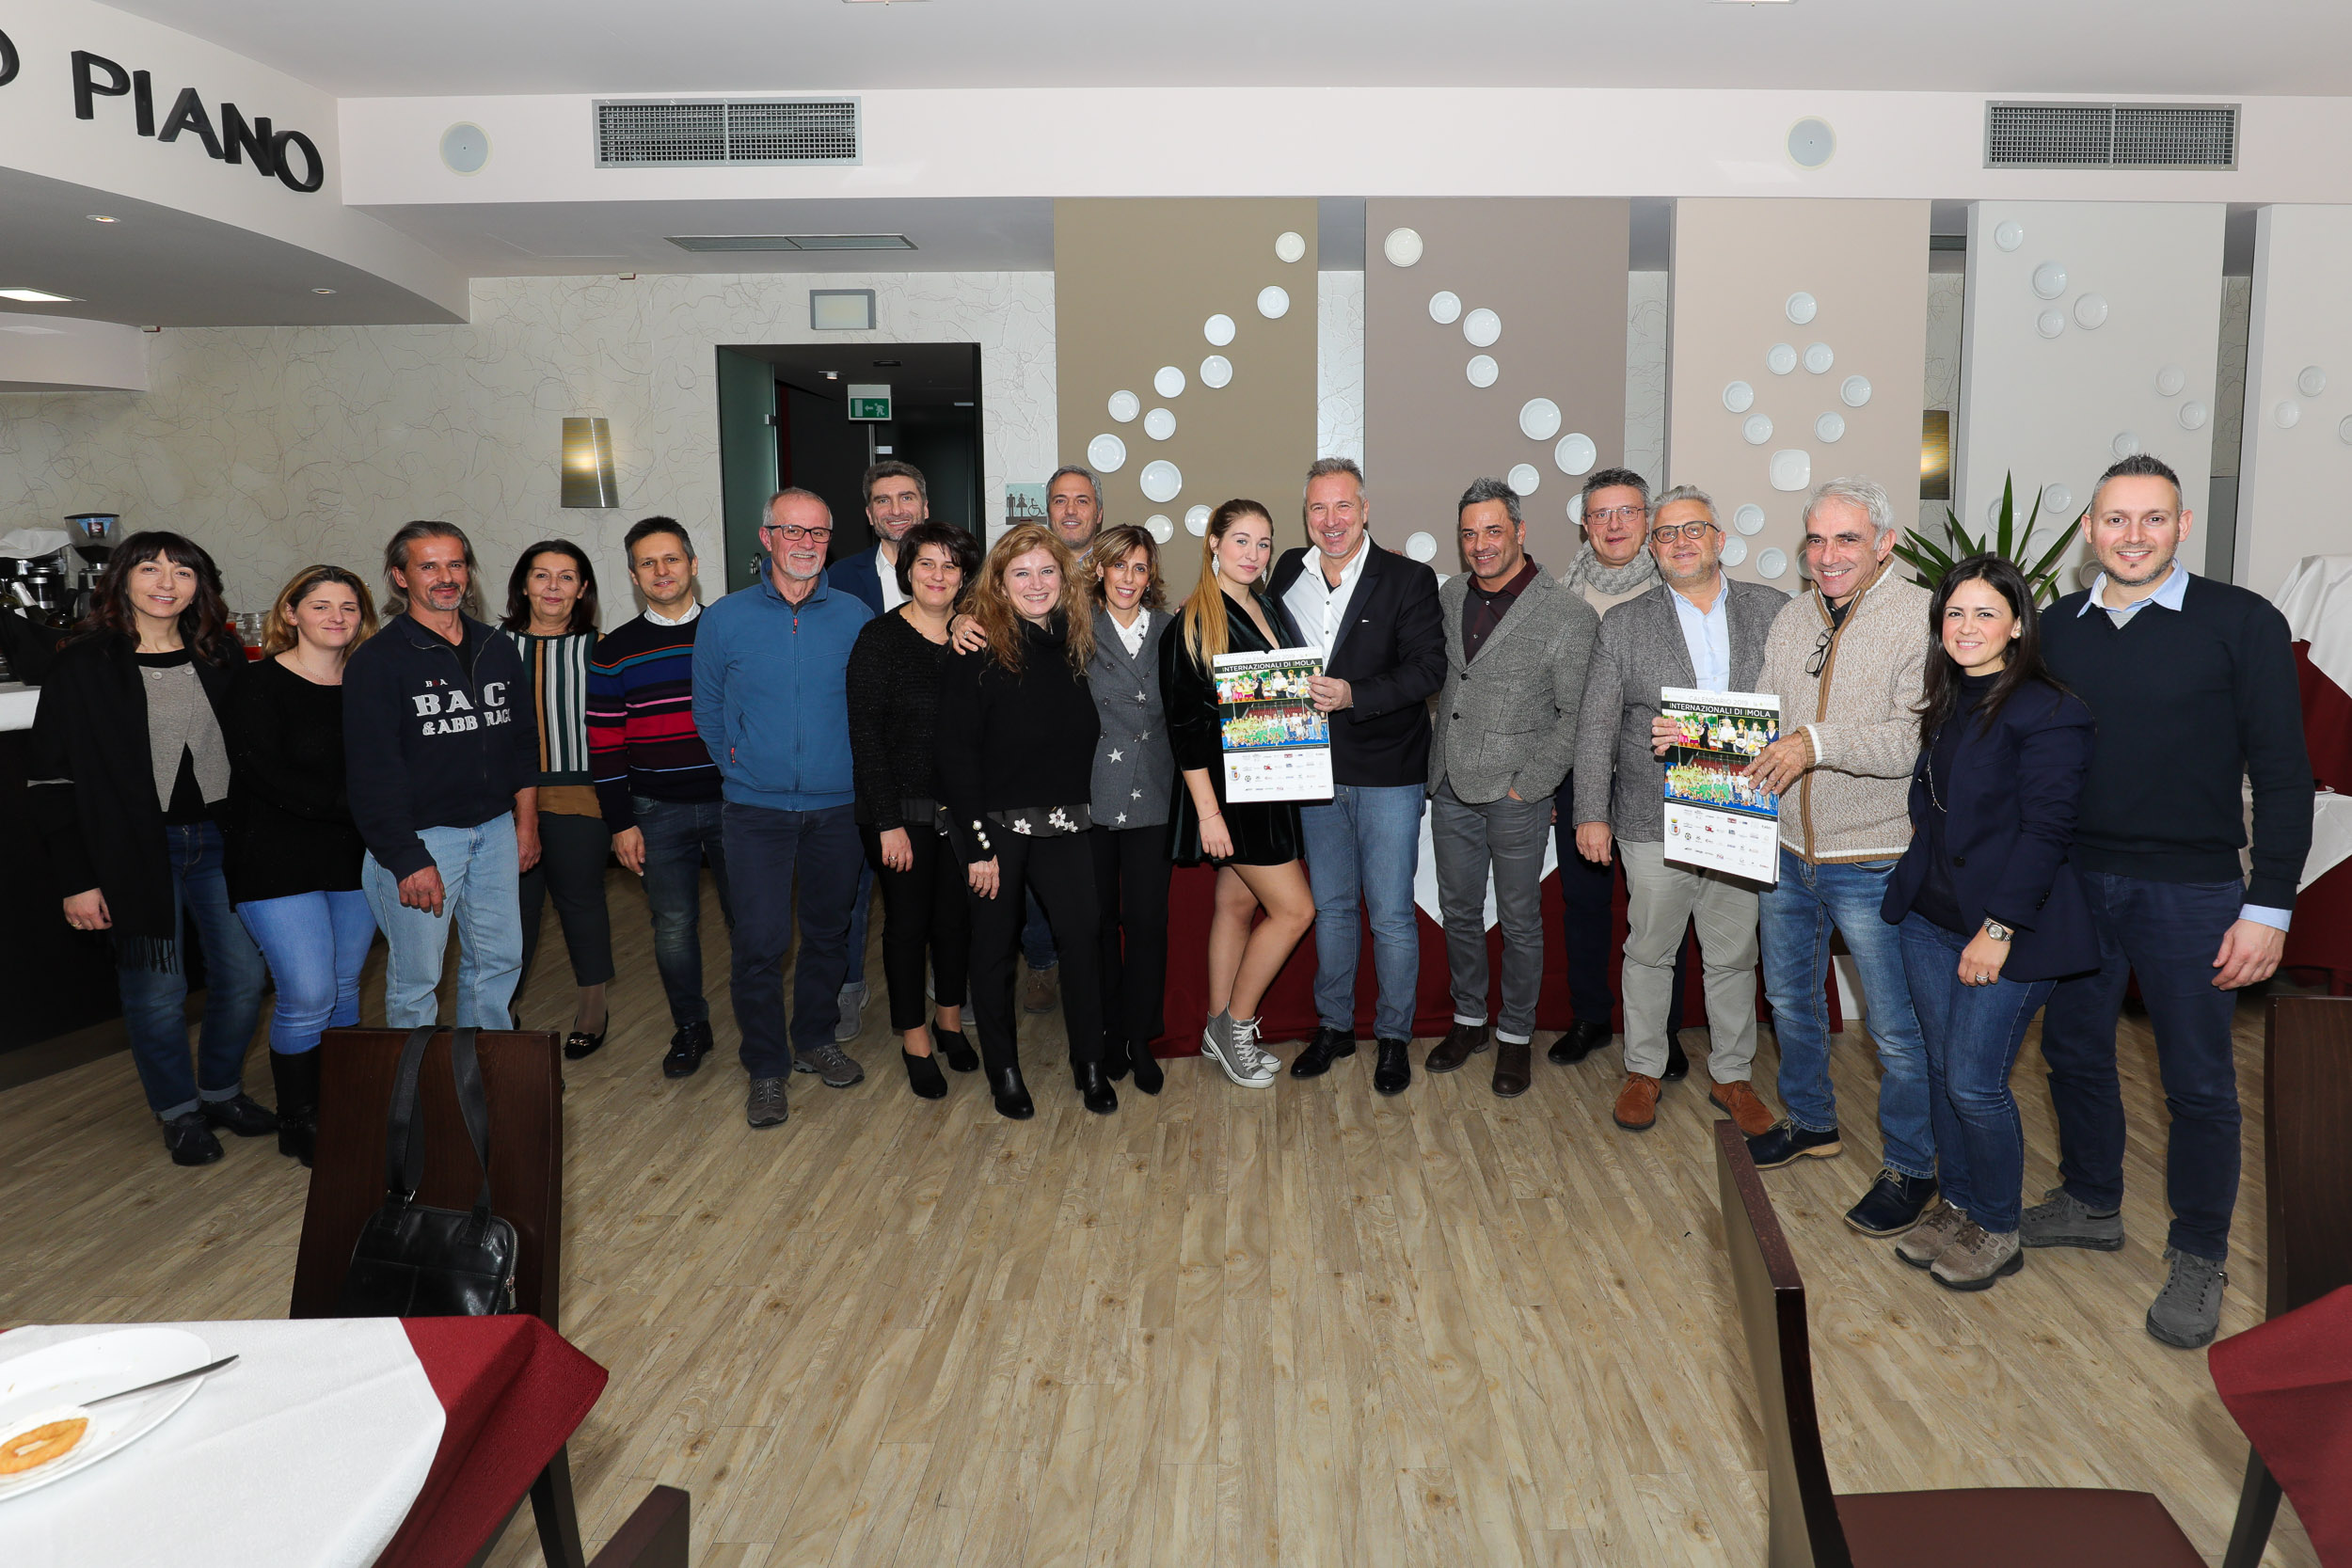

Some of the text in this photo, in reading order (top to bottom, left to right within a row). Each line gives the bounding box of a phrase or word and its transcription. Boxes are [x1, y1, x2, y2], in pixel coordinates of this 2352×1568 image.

[72, 50, 325, 193] PIANO
[1241, 655, 1280, 663] CALENDARIO
[1222, 662, 1282, 673] INTERNAZIONALI
[1689, 696, 1732, 705] CALENDARIO
[1669, 702, 1772, 718] INTERNAZIONALI DI IMOLA
